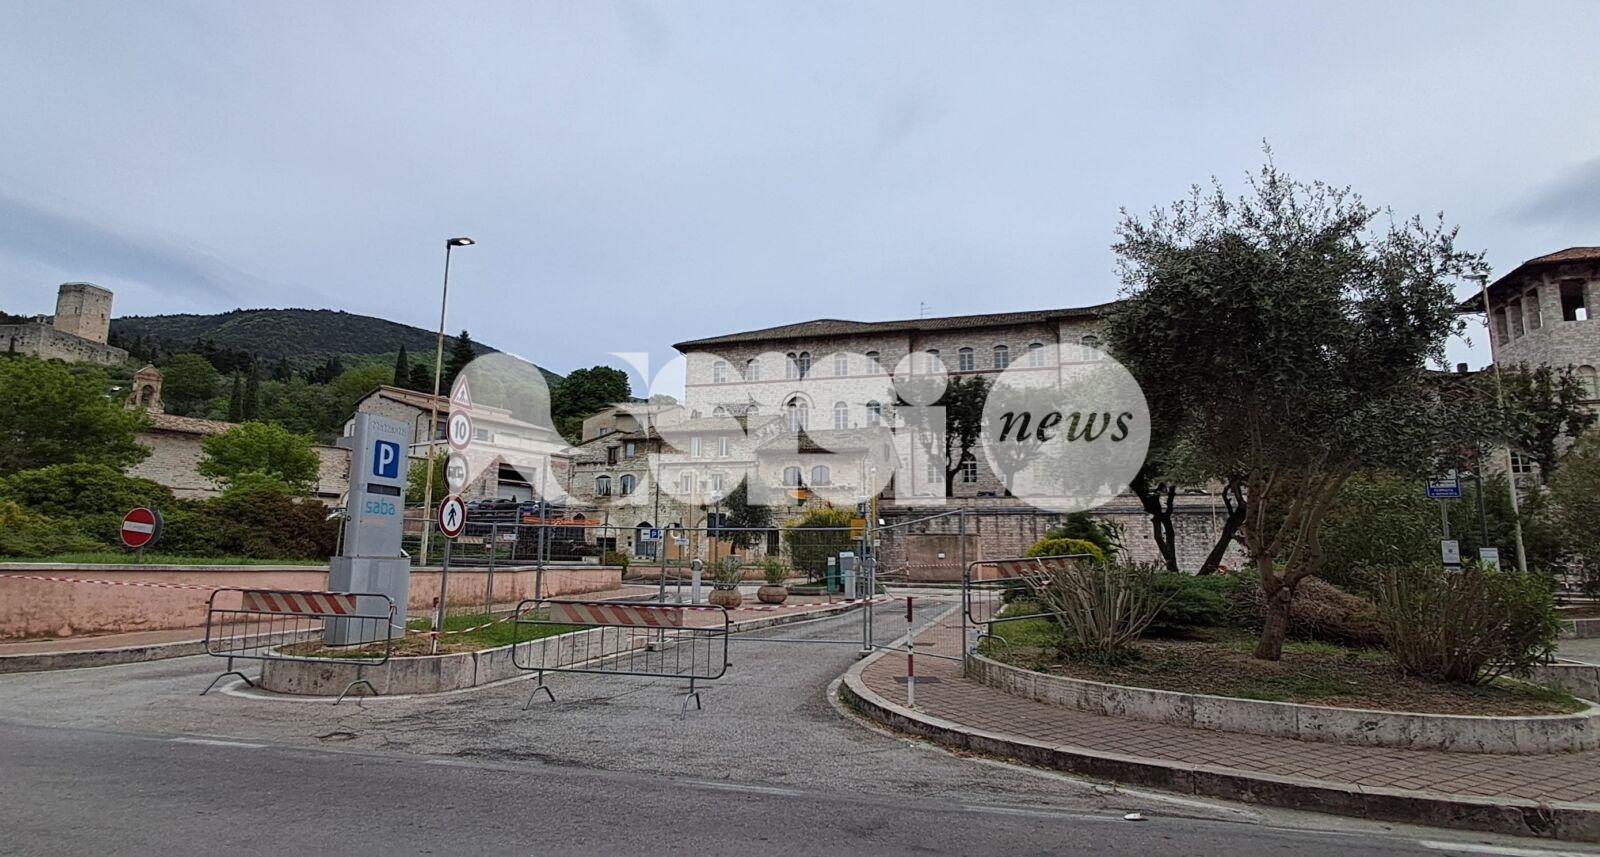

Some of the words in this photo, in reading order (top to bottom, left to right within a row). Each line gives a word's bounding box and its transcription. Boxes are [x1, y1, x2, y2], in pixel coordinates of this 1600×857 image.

[455, 420, 466, 439] 10
[378, 443, 394, 475] P
[365, 498, 395, 515] saba
